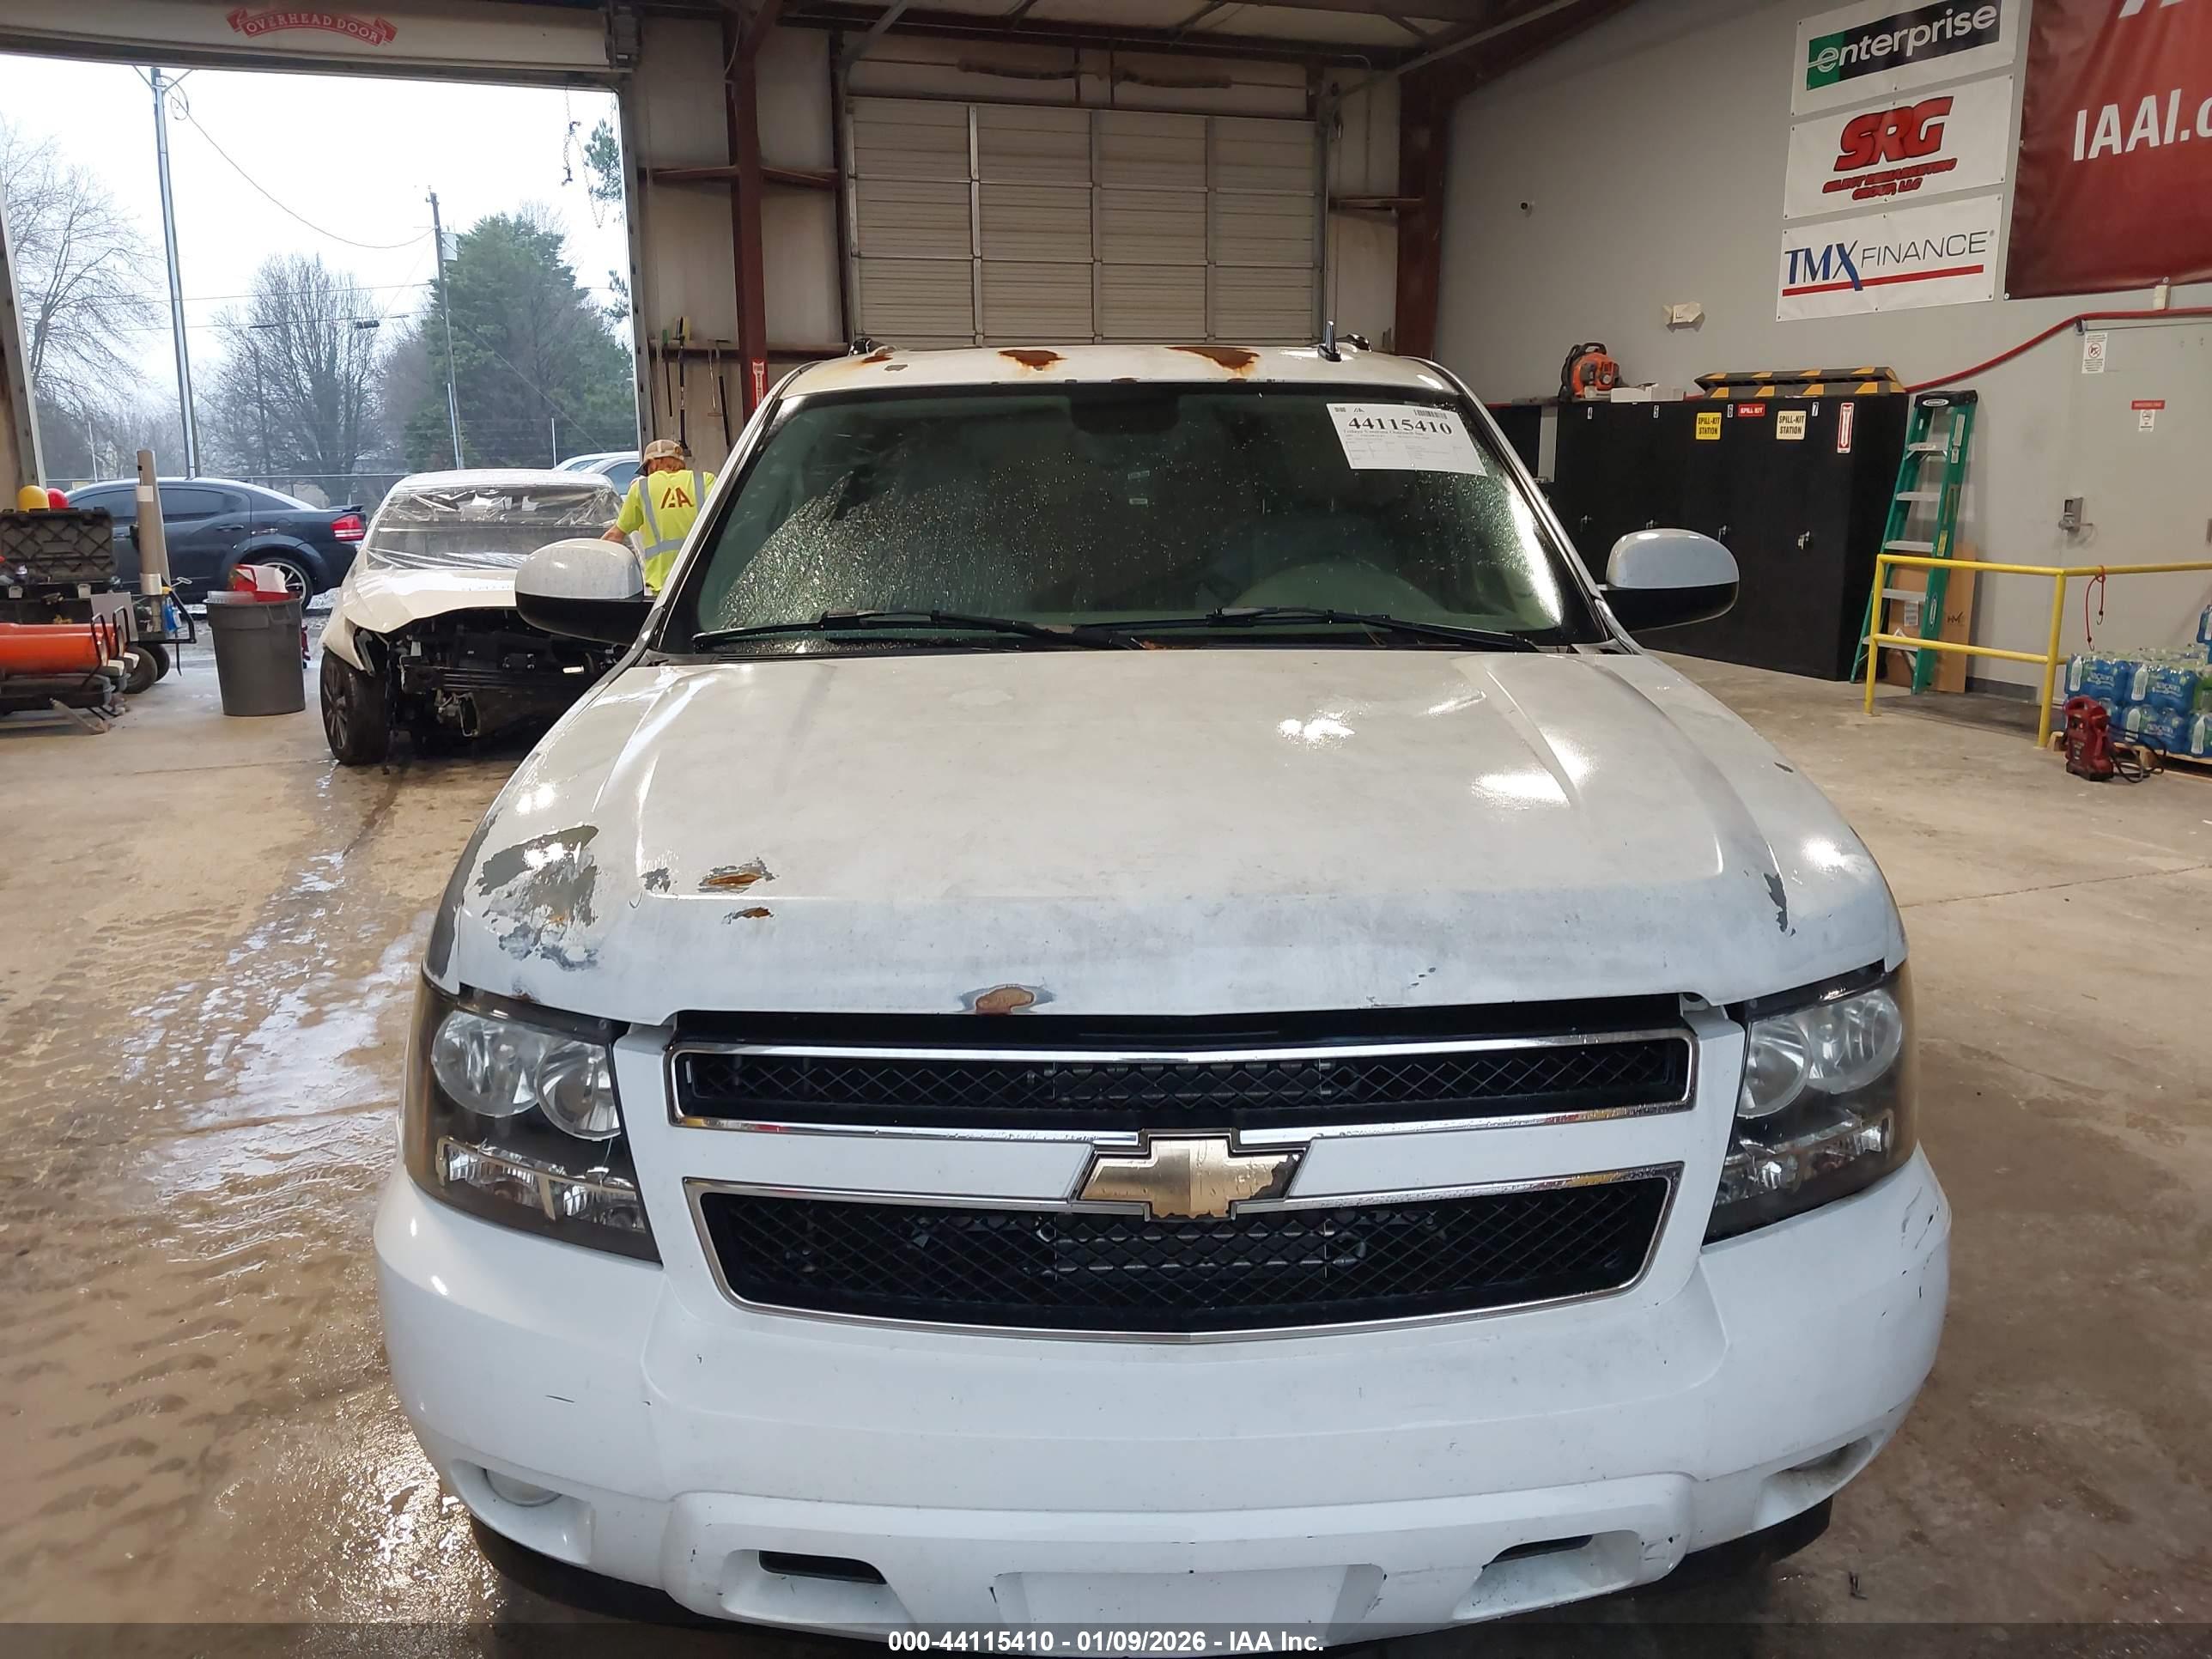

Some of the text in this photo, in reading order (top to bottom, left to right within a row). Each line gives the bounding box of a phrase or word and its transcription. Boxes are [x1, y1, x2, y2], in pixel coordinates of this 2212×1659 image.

[246, 13, 379, 42] OVERHEAD DOOR
[1808, 3, 1997, 72] enterprise
[1833, 96, 1954, 172] SRG
[1784, 231, 1988, 291] TMX FINANCE
[1349, 417, 1453, 435] 44115410
[1778, 415, 1804, 423] SPILL-KIT
[1779, 426, 1802, 434] STATION
